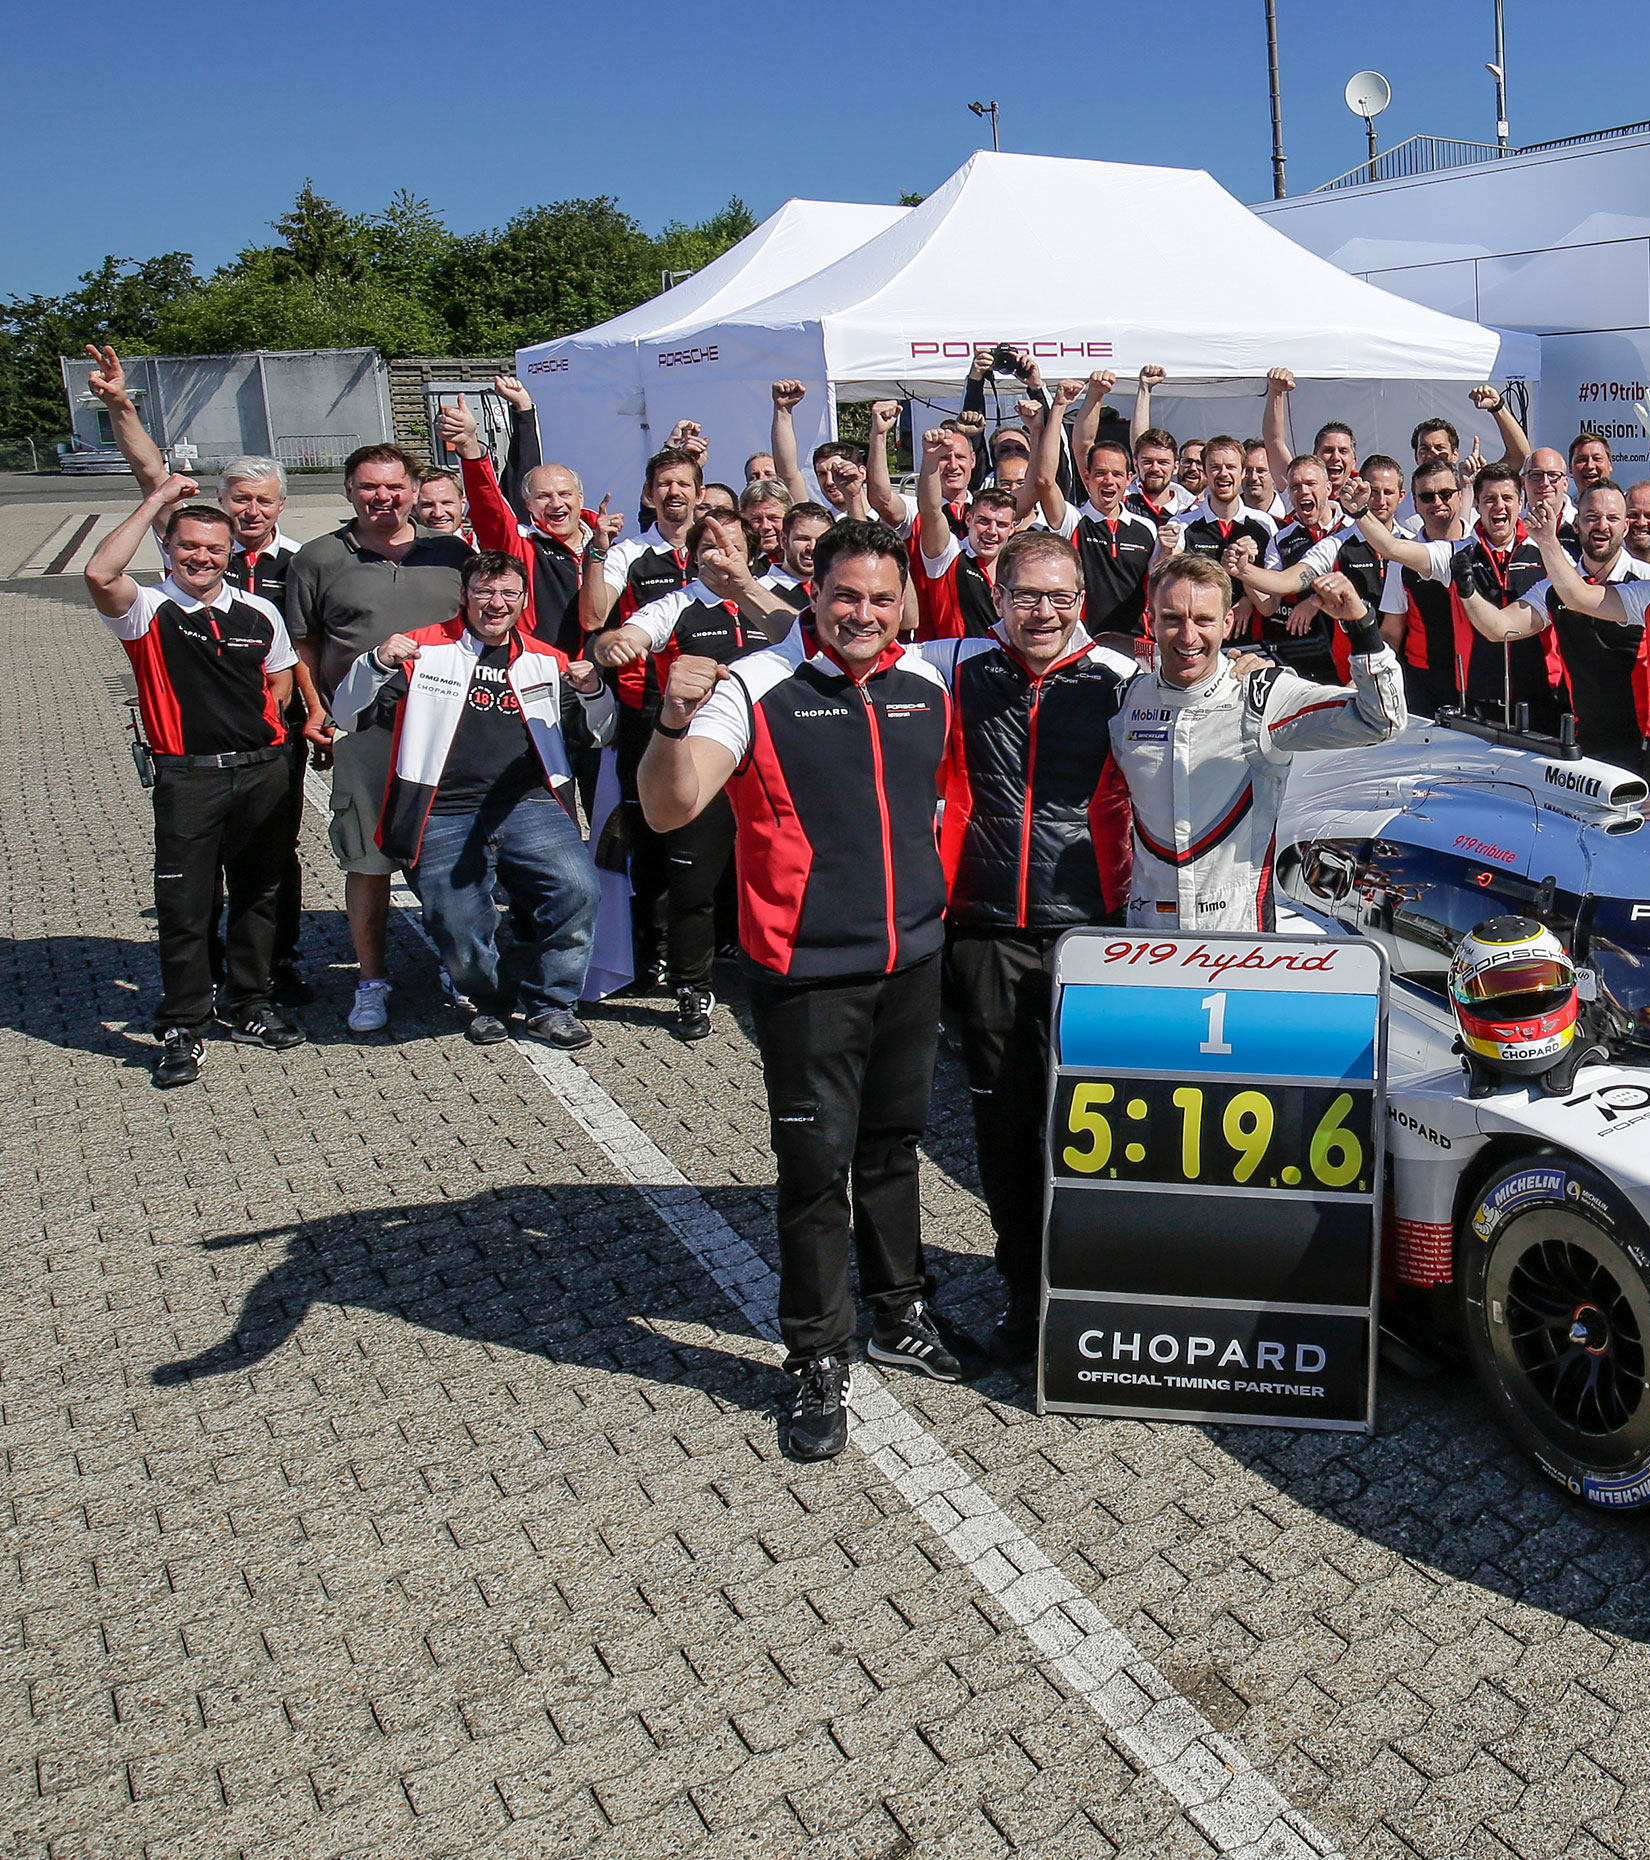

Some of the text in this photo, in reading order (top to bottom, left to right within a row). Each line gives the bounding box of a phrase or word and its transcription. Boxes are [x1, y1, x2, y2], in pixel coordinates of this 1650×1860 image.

[528, 358, 568, 374] PORSCHE
[658, 346, 718, 368] PORSCHE
[1580, 420, 1638, 438] Mission:
[692, 630, 728, 638] CHOPARD
[417, 684, 459, 697] CHOPARD
[474, 692, 489, 706] 18
[794, 708, 849, 718] CHOPARD
[1132, 709, 1171, 721] Mobil 1
[1544, 766, 1602, 798] Mobil 1
[1452, 835, 1518, 864] 919 tribute
[1198, 900, 1226, 913] Timo
[1102, 942, 1339, 982] 919 hybrid
[1462, 949, 1572, 983] PORSCHE
[1199, 992, 1232, 1054] 1
[1502, 1042, 1559, 1059] CHOPARD
[1063, 1082, 1363, 1187] 5:19.6
[1386, 1105, 1452, 1150] HOPARD
[1494, 1175, 1561, 1207] MICHELIN
[1582, 1190, 1609, 1211] MICHELIN
[1078, 1330, 1326, 1373] CHOPARD
[1078, 1370, 1325, 1397] OFFICIAL TIMING PARTNER
